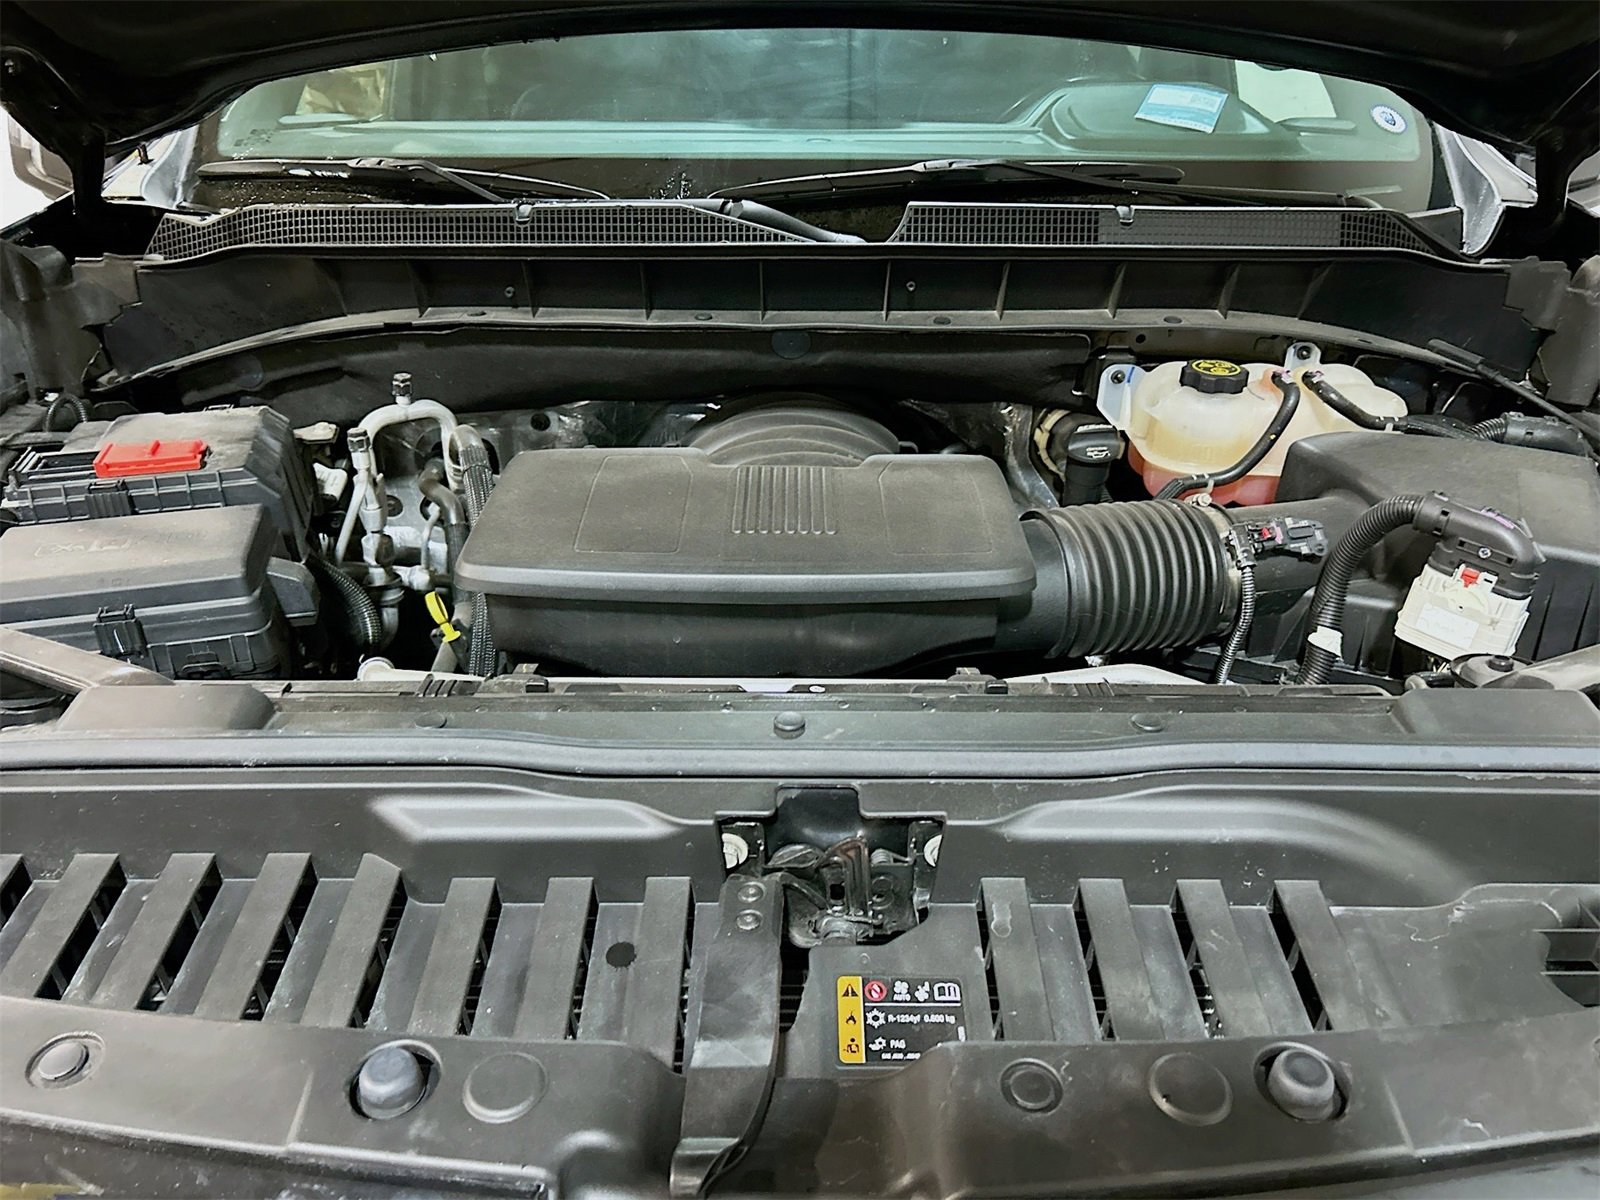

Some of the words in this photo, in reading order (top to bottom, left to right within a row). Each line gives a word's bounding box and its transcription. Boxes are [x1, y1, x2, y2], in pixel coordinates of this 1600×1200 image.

[887, 1014, 921, 1024] R-1234yf
[945, 1014, 955, 1024] kg
[890, 1039, 906, 1049] PAG
